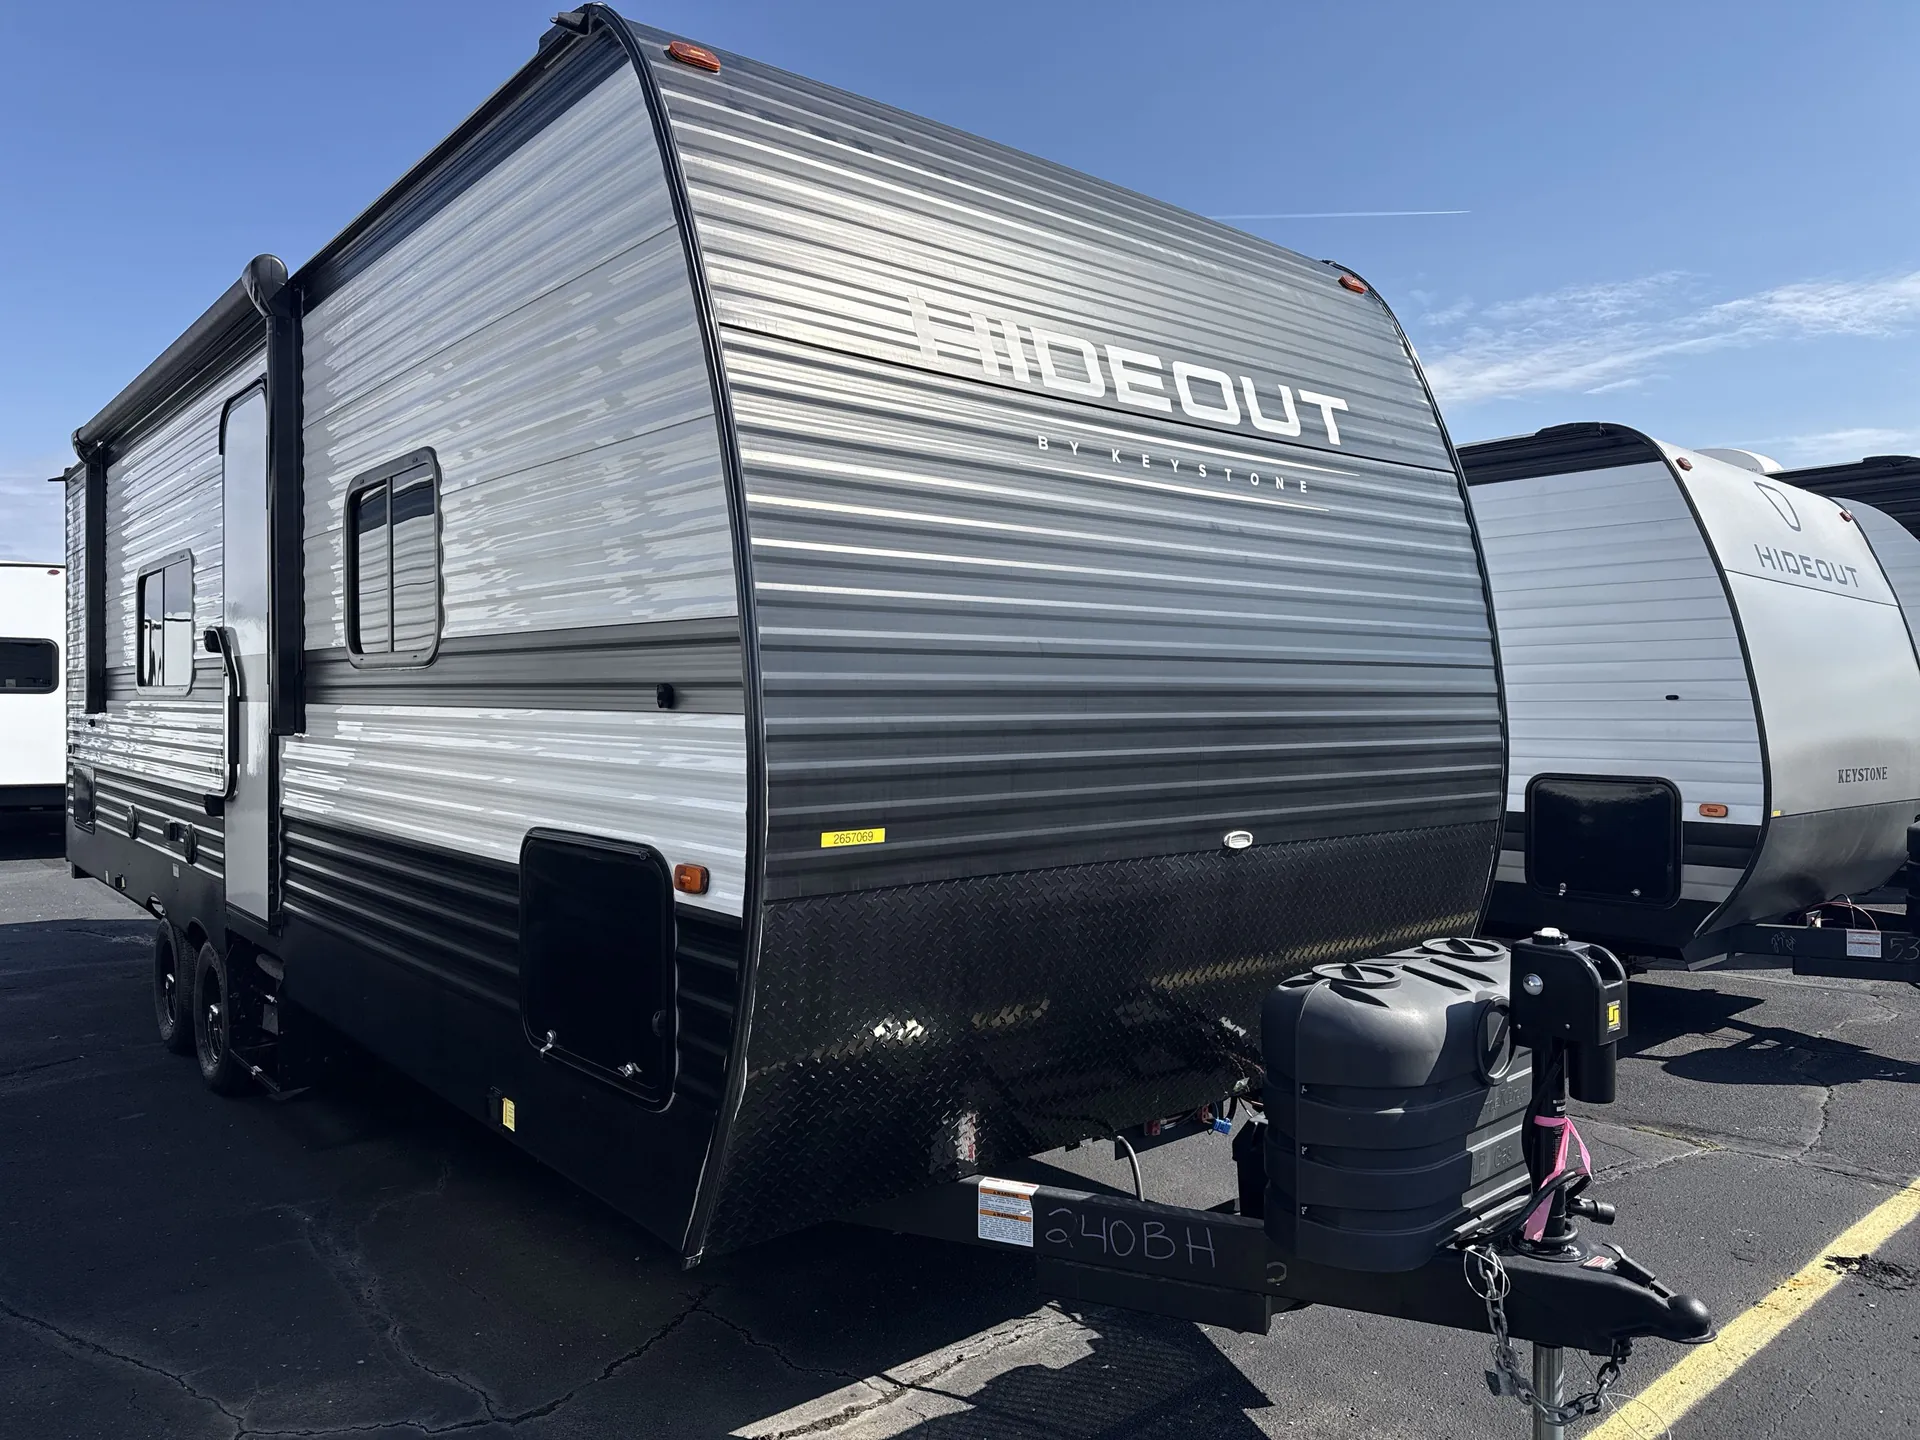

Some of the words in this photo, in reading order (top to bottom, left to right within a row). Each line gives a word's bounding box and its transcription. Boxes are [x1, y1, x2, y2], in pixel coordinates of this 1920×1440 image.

[907, 296, 1349, 445] HIDEOUT
[1037, 434, 1080, 457] BY
[1111, 448, 1308, 494] KEYSTONE
[1753, 543, 1859, 588] HIDEOUT
[1837, 766, 1888, 784] KEYSTONE
[833, 831, 874, 845] 2657069
[1044, 1207, 1217, 1269] 240BH
